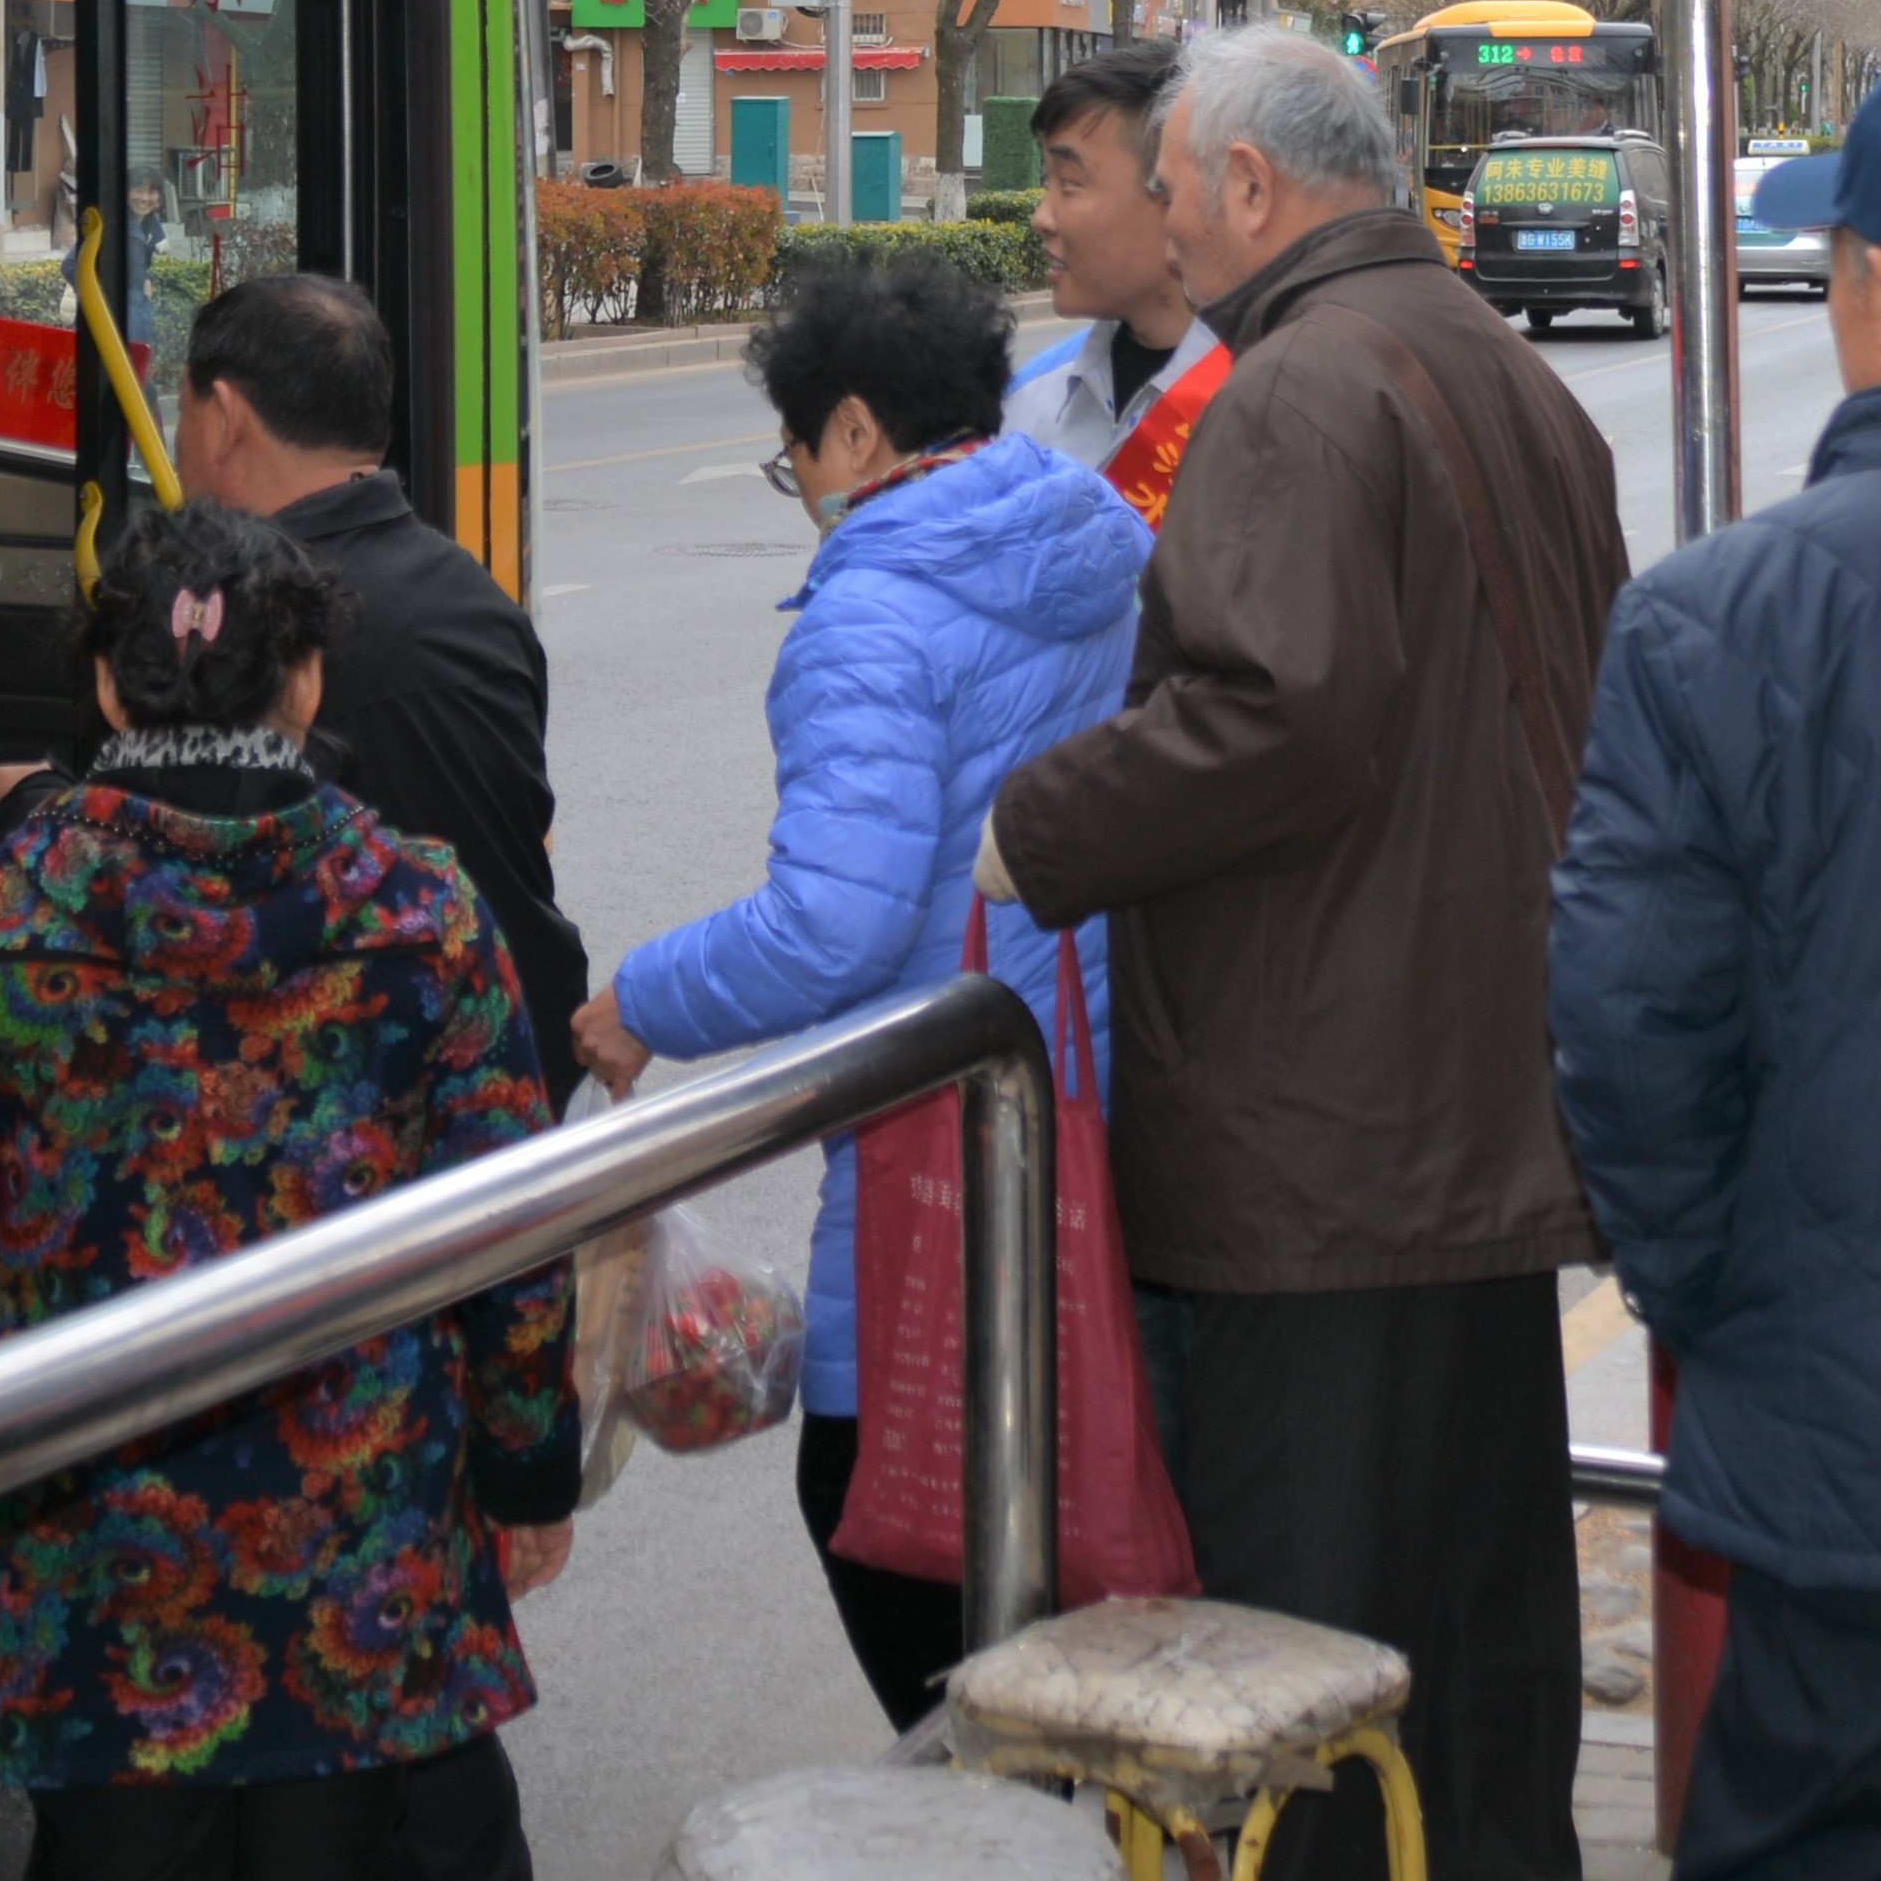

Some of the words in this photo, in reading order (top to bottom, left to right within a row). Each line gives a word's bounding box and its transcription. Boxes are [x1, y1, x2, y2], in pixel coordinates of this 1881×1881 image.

[1478, 45, 1513, 63] 312
[1485, 156, 1608, 181] 阿朱专业美缝
[1484, 182, 1605, 204] 13863631673
